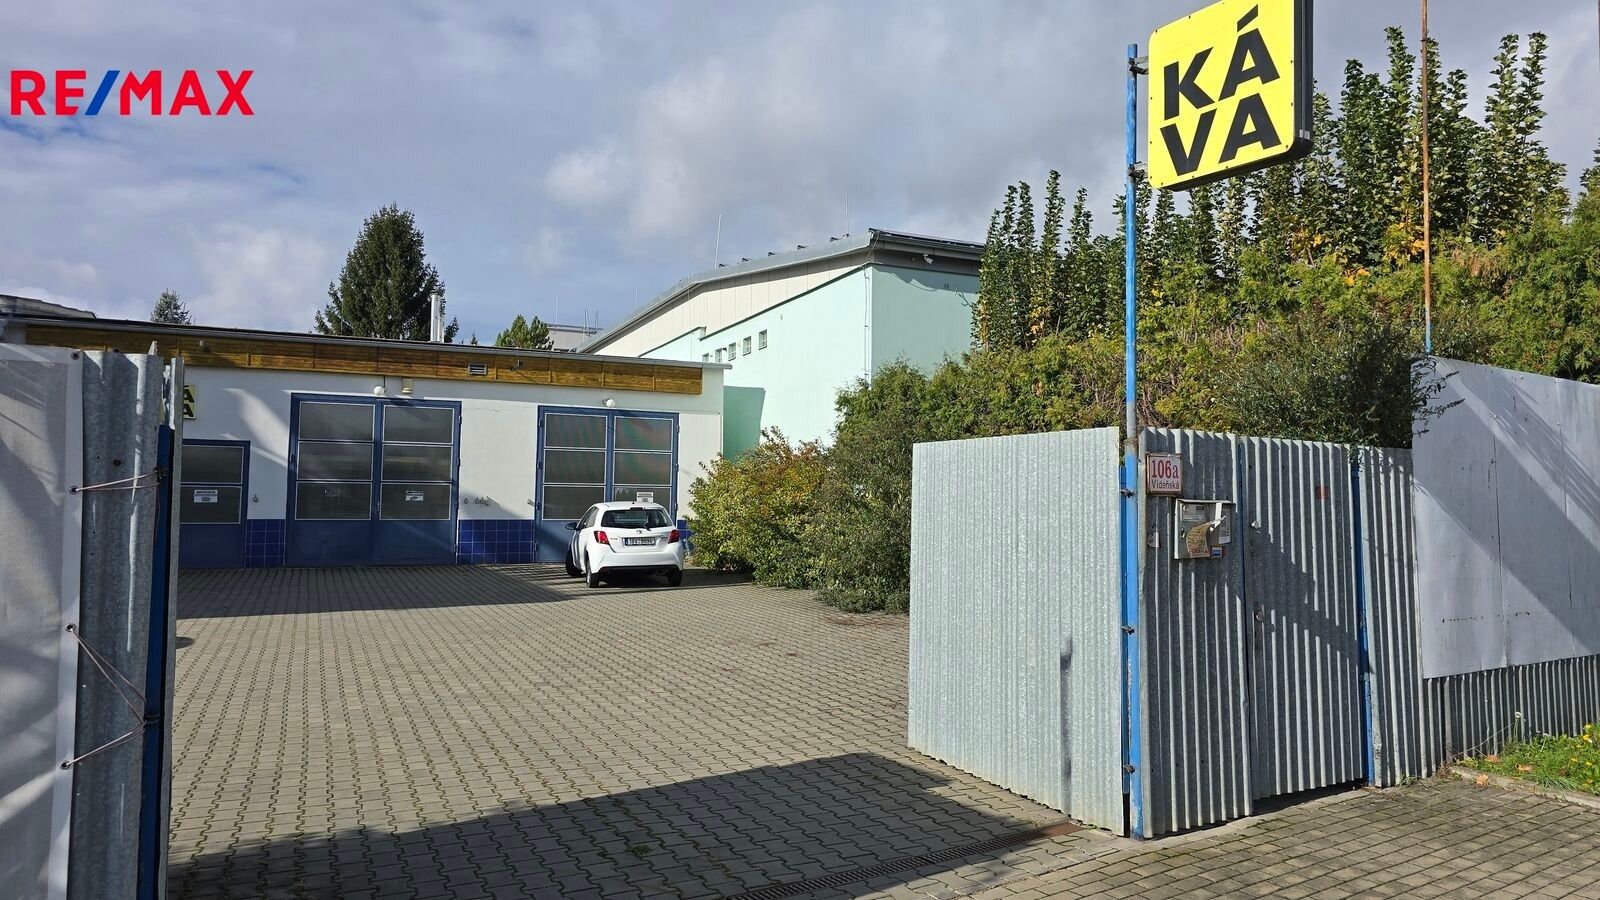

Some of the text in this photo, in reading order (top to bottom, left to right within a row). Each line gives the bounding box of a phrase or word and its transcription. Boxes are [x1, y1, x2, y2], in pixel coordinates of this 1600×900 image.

[1163, 4, 1281, 121] KÁ
[1159, 92, 1282, 177] VA
[183, 385, 195, 403] Á
[183, 403, 195, 418] A
[1151, 459, 1179, 479] 106a
